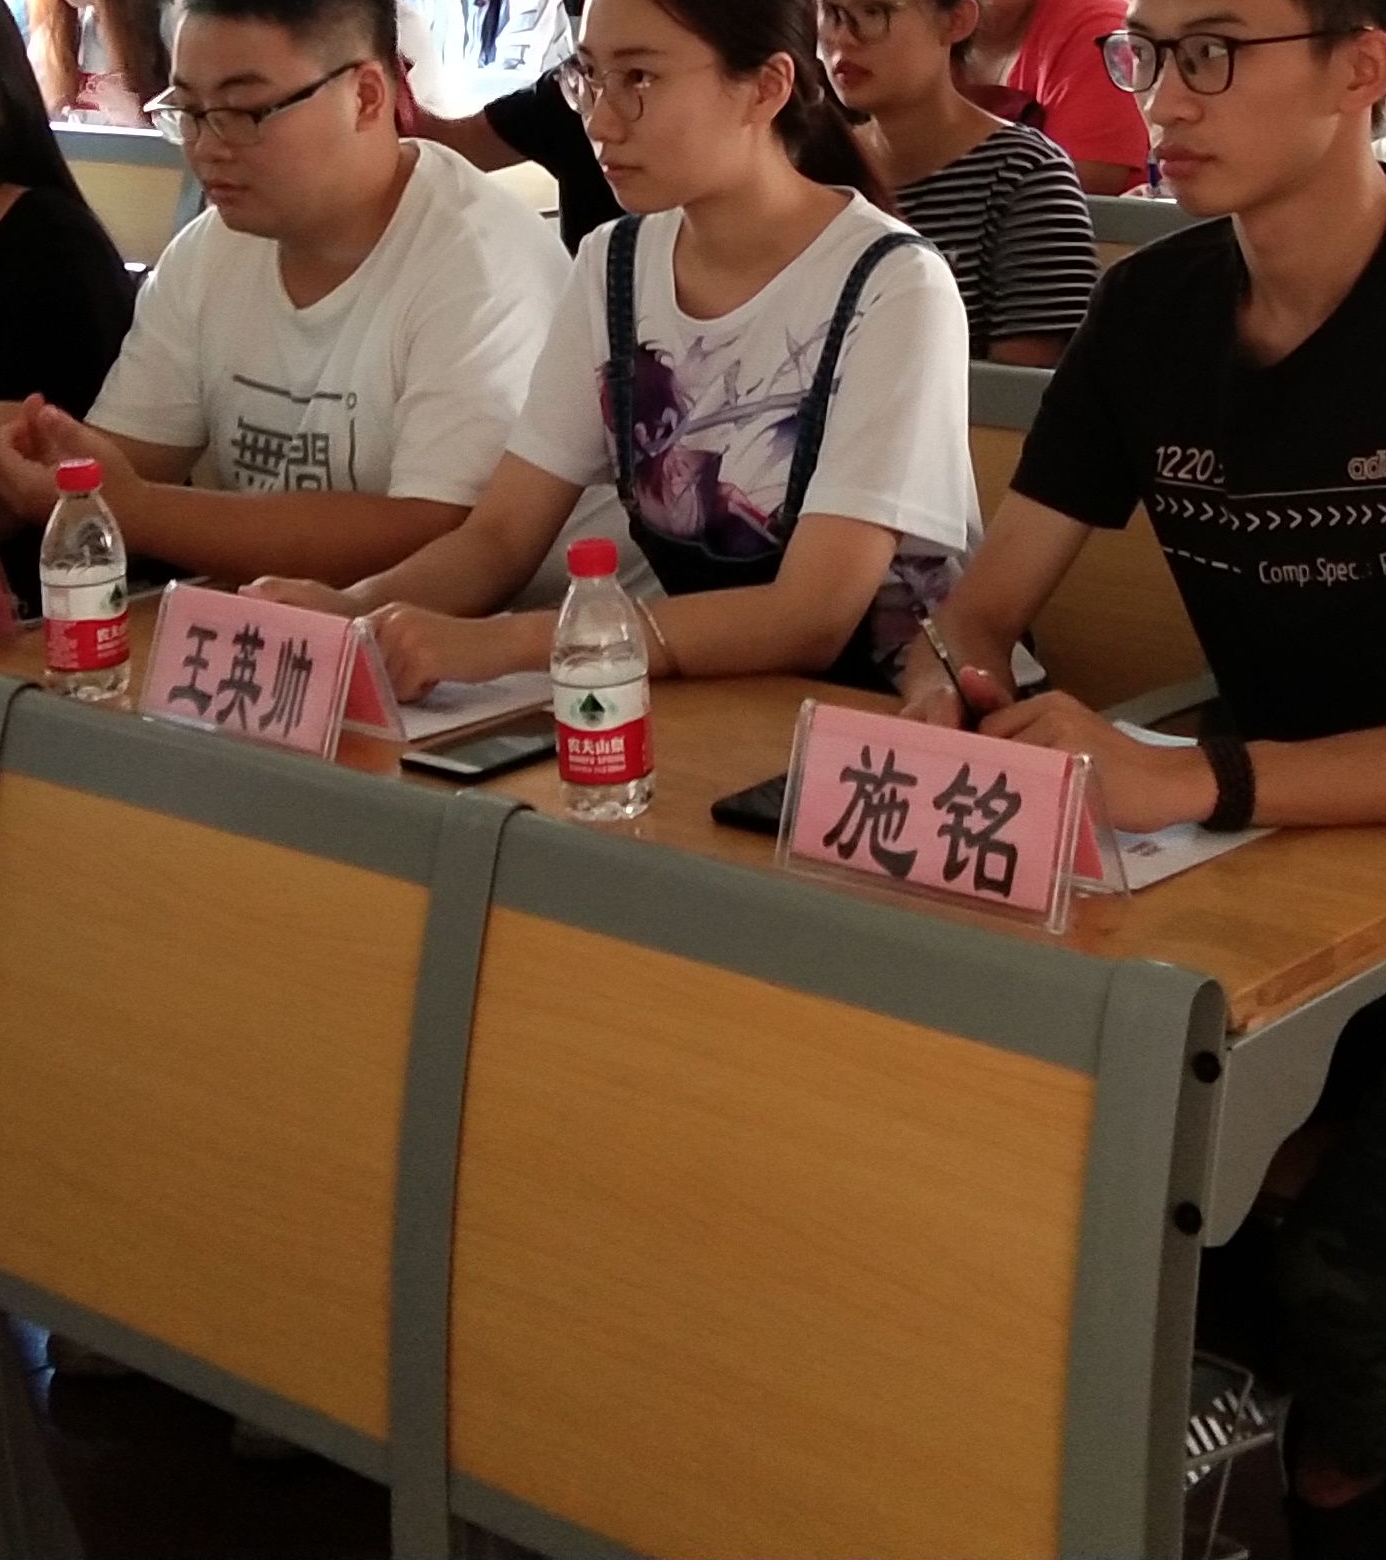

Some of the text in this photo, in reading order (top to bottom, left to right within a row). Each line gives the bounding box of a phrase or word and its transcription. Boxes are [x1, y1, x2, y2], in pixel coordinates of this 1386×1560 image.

[167, 623, 313, 739] 王英帅
[822, 744, 1022, 899] 施铭
